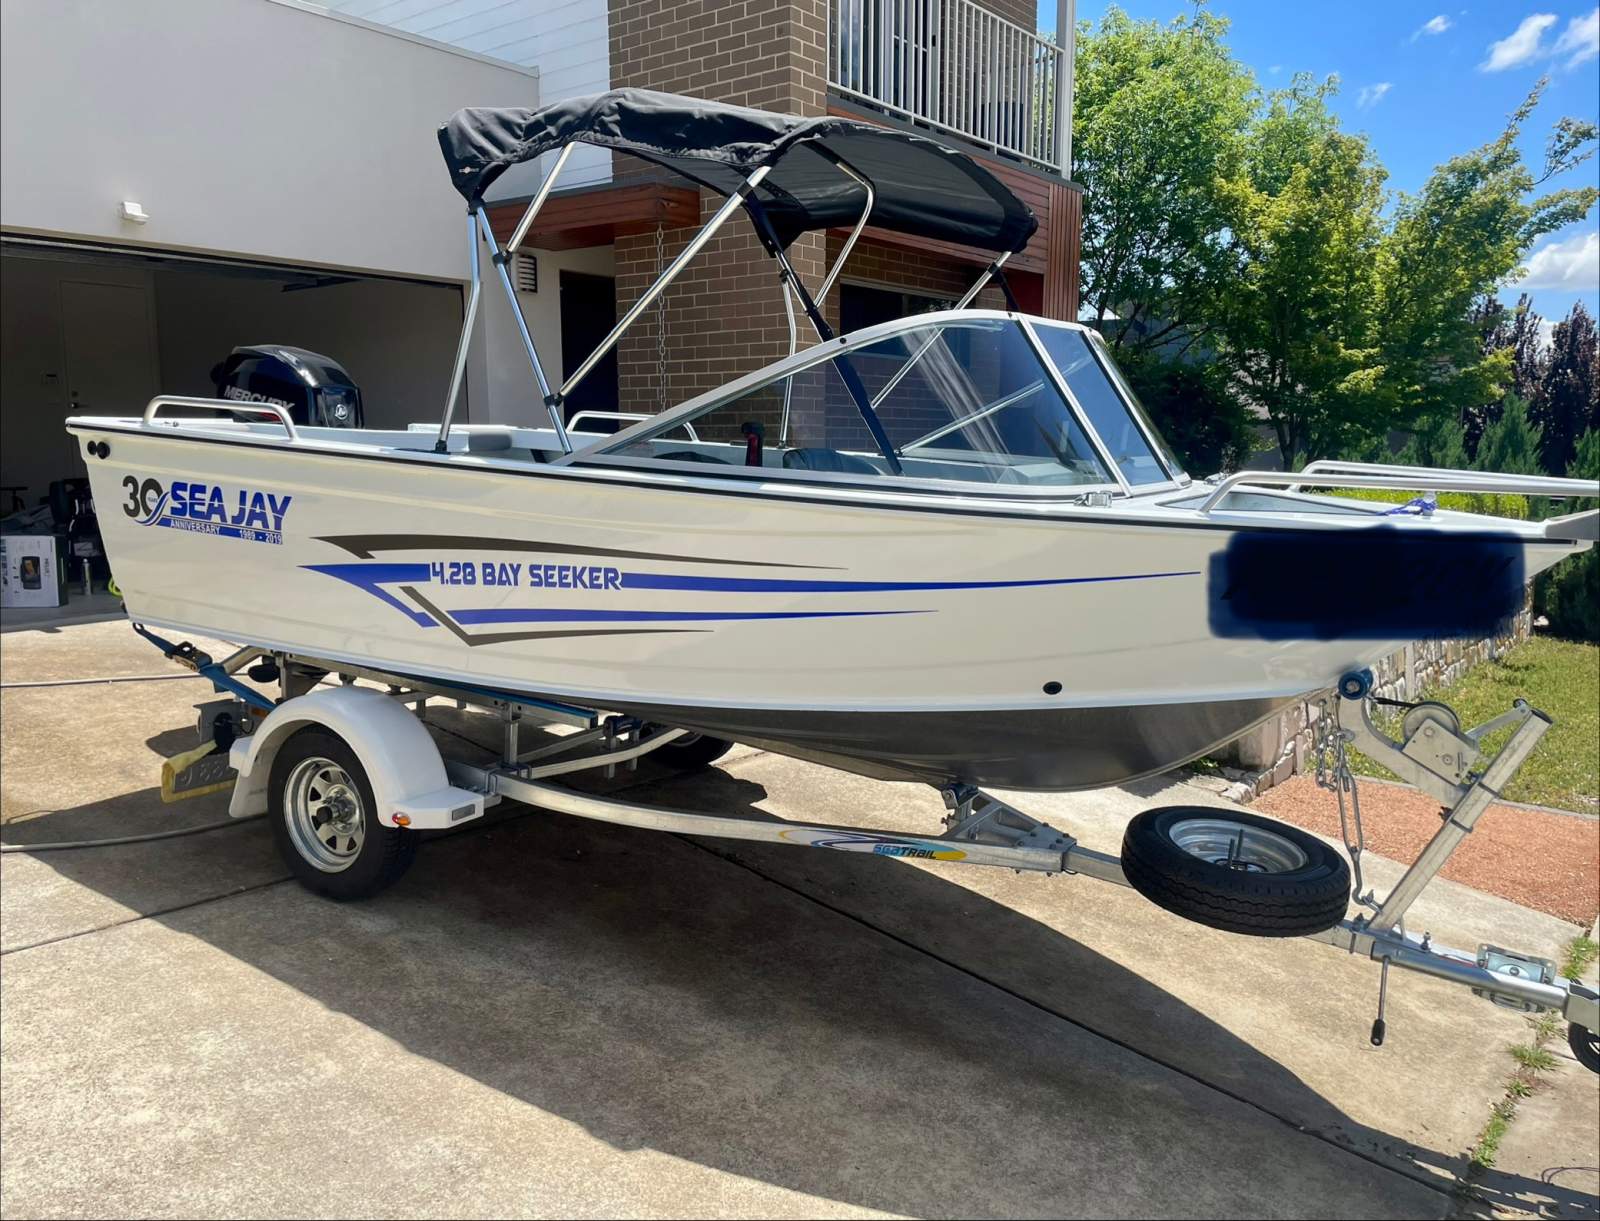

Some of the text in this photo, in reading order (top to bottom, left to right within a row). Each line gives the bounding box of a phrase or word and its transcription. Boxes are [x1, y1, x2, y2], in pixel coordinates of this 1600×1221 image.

[122, 475, 164, 518] 30
[170, 481, 292, 530] SEA JAY
[170, 519, 220, 535] ANNIVERSARY
[265, 533, 283, 545] 2019
[432, 562, 621, 590] 4.28 BAY SEEKER
